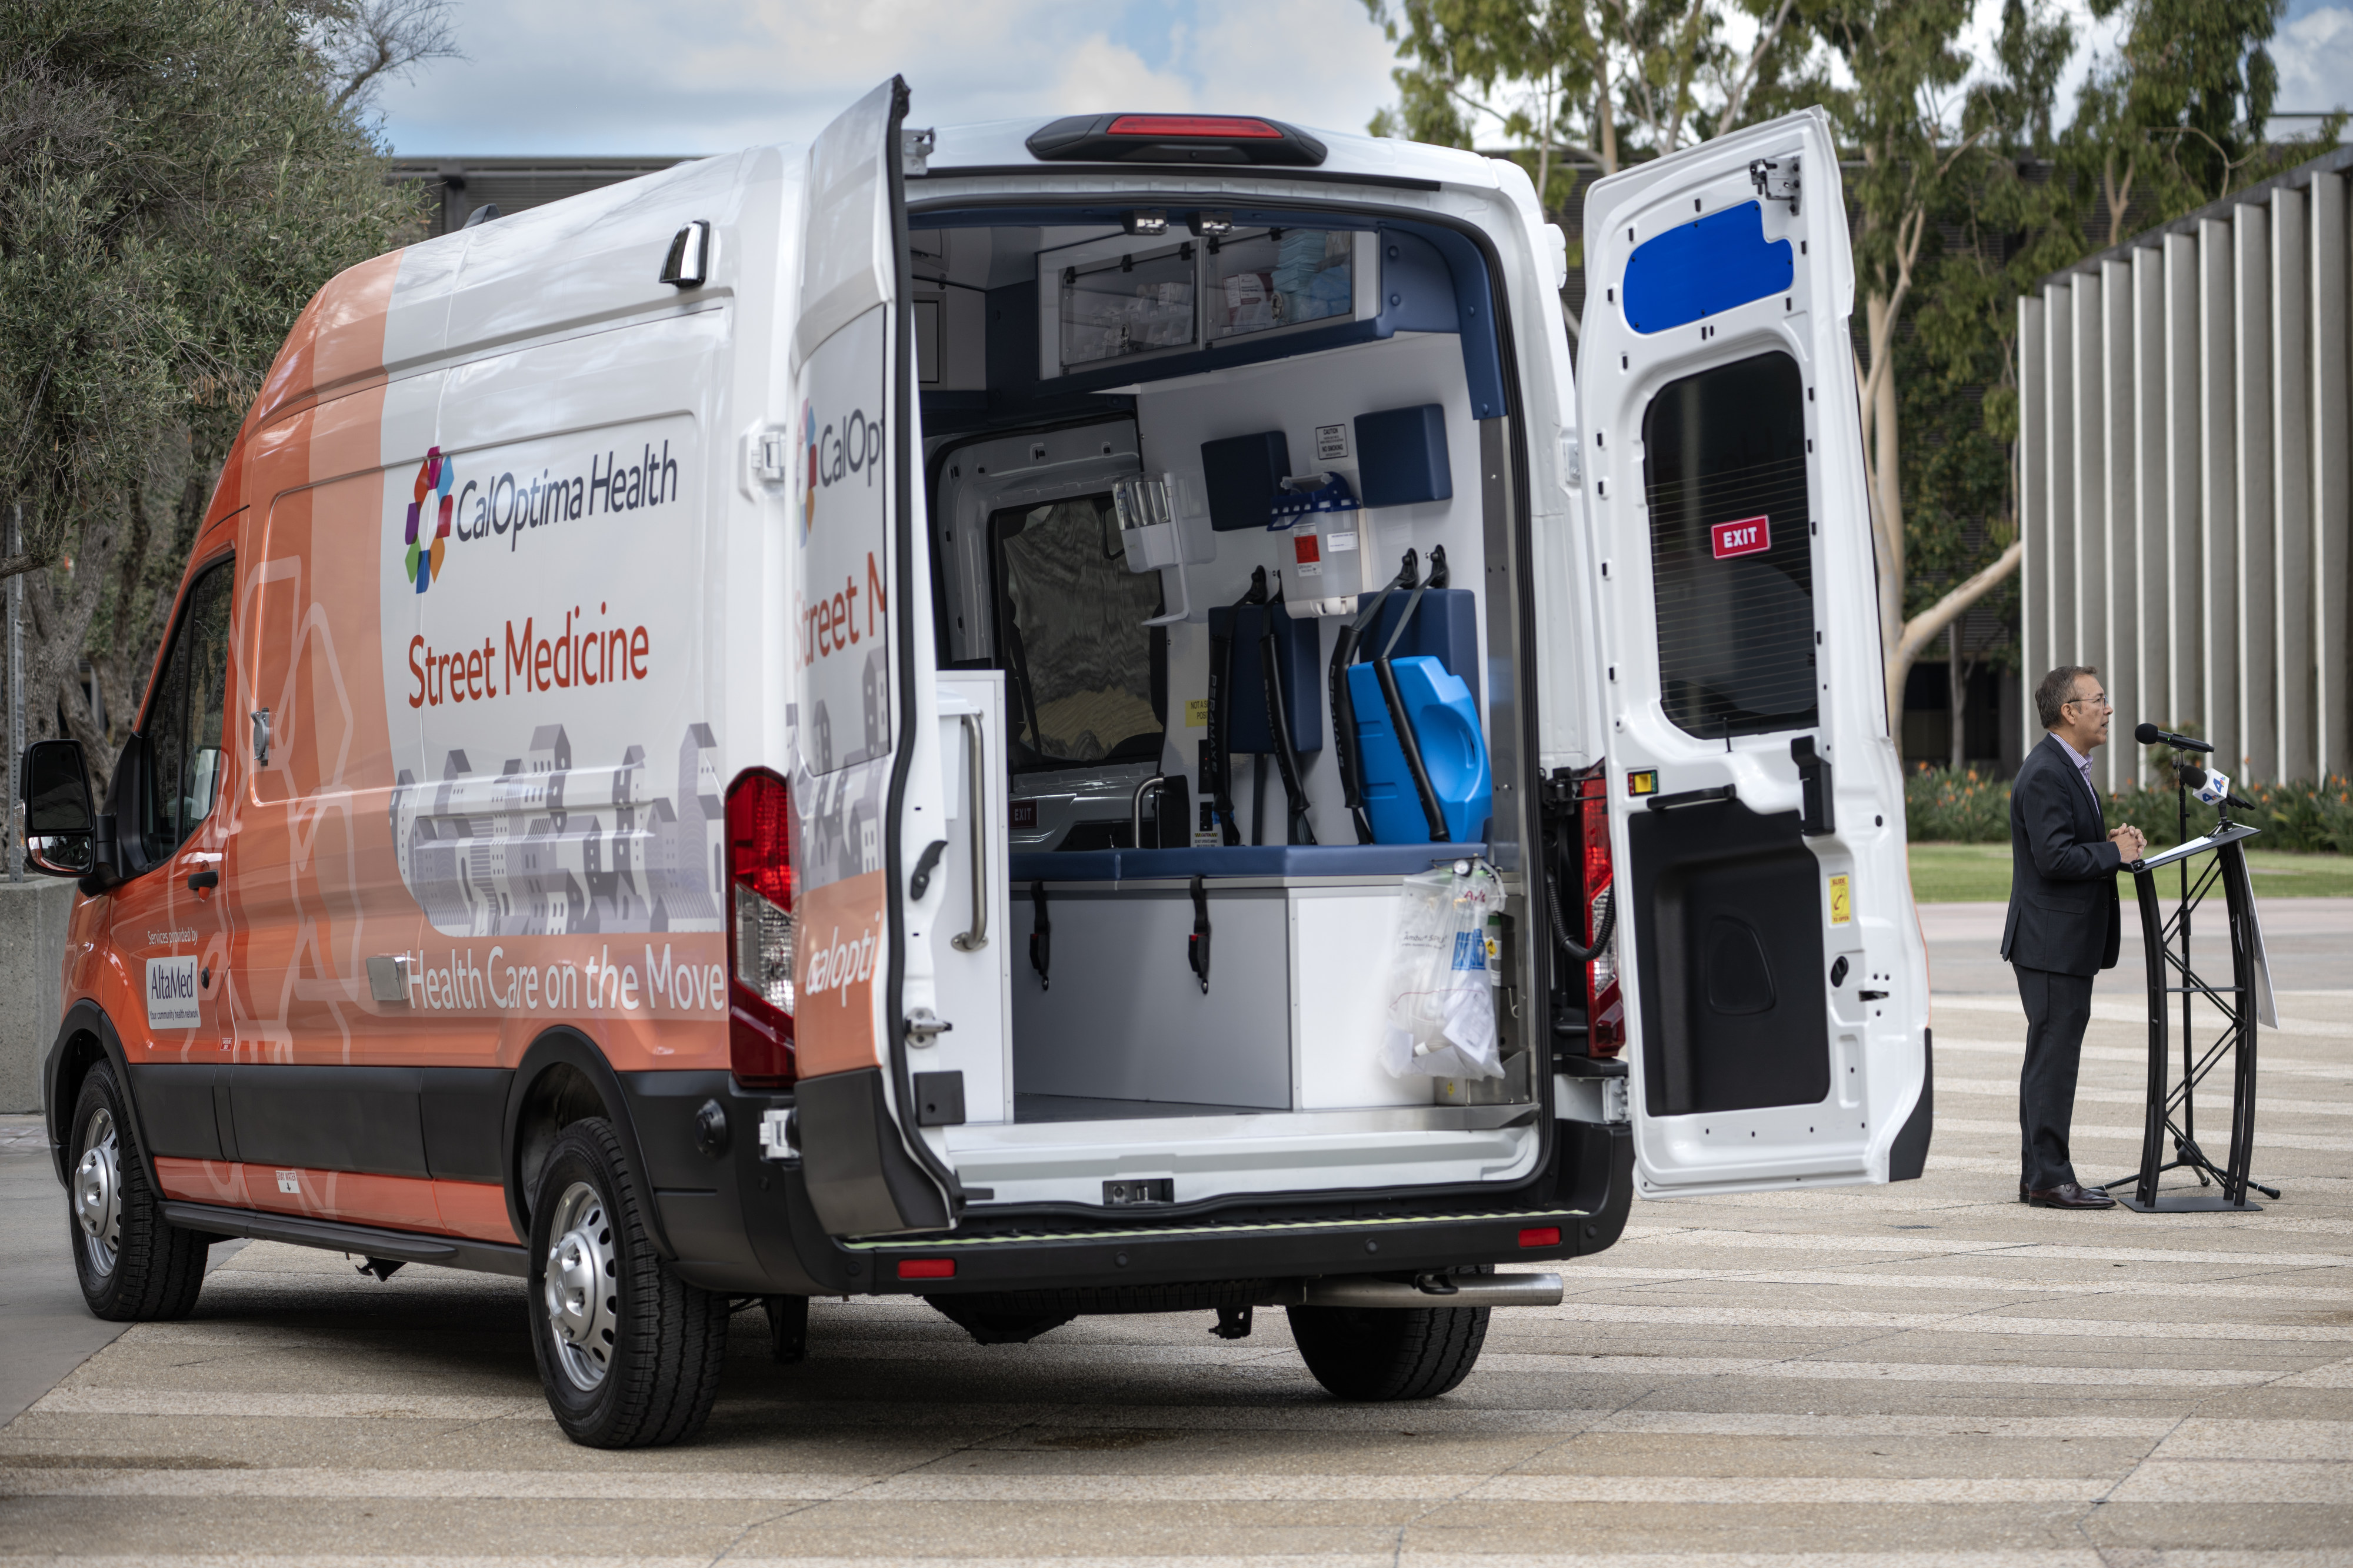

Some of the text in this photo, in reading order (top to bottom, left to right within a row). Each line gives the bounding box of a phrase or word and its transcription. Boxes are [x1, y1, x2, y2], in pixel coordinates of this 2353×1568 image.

[456, 439, 678, 552] CalOptima Health
[1723, 526, 1757, 548] EXIT
[795, 576, 859, 673] Street
[409, 601, 649, 708] Street Medicine
[1191, 701, 1199, 709] NOT
[1200, 700, 1204, 709] A
[2213, 778, 2224, 793] 4
[2202, 793, 2214, 802] 4
[1015, 808, 1031, 821] EXIT
[148, 927, 198, 948] Services provided by
[151, 962, 193, 999] AltaMed
[406, 943, 724, 1011] Health Care on the Move
[157, 1010, 174, 1020] community
[174, 1009, 185, 1019] health
[185, 1009, 199, 1019] network
[285, 1172, 296, 1181] WATER
